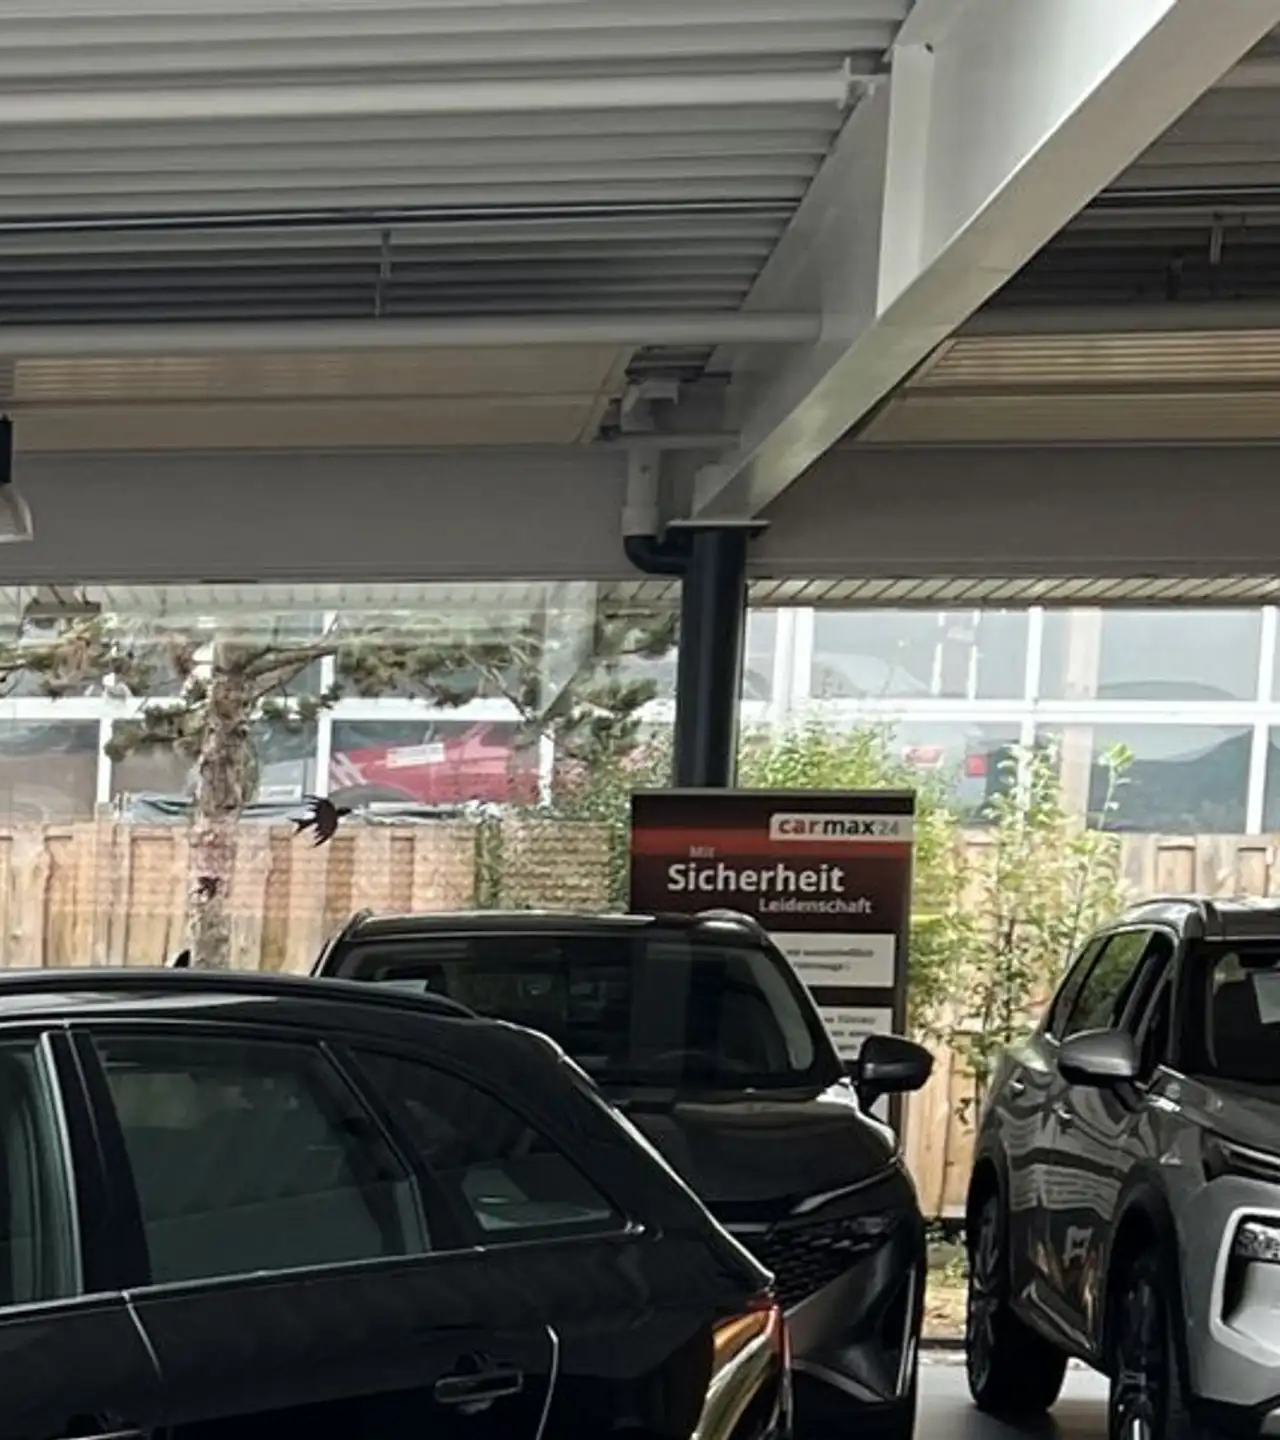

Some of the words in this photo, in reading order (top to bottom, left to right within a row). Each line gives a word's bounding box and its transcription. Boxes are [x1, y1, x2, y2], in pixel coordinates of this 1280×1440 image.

[778, 817, 900, 836] carmax24
[667, 863, 845, 892] Sicherheit
[758, 898, 873, 914] Leidenschaft
